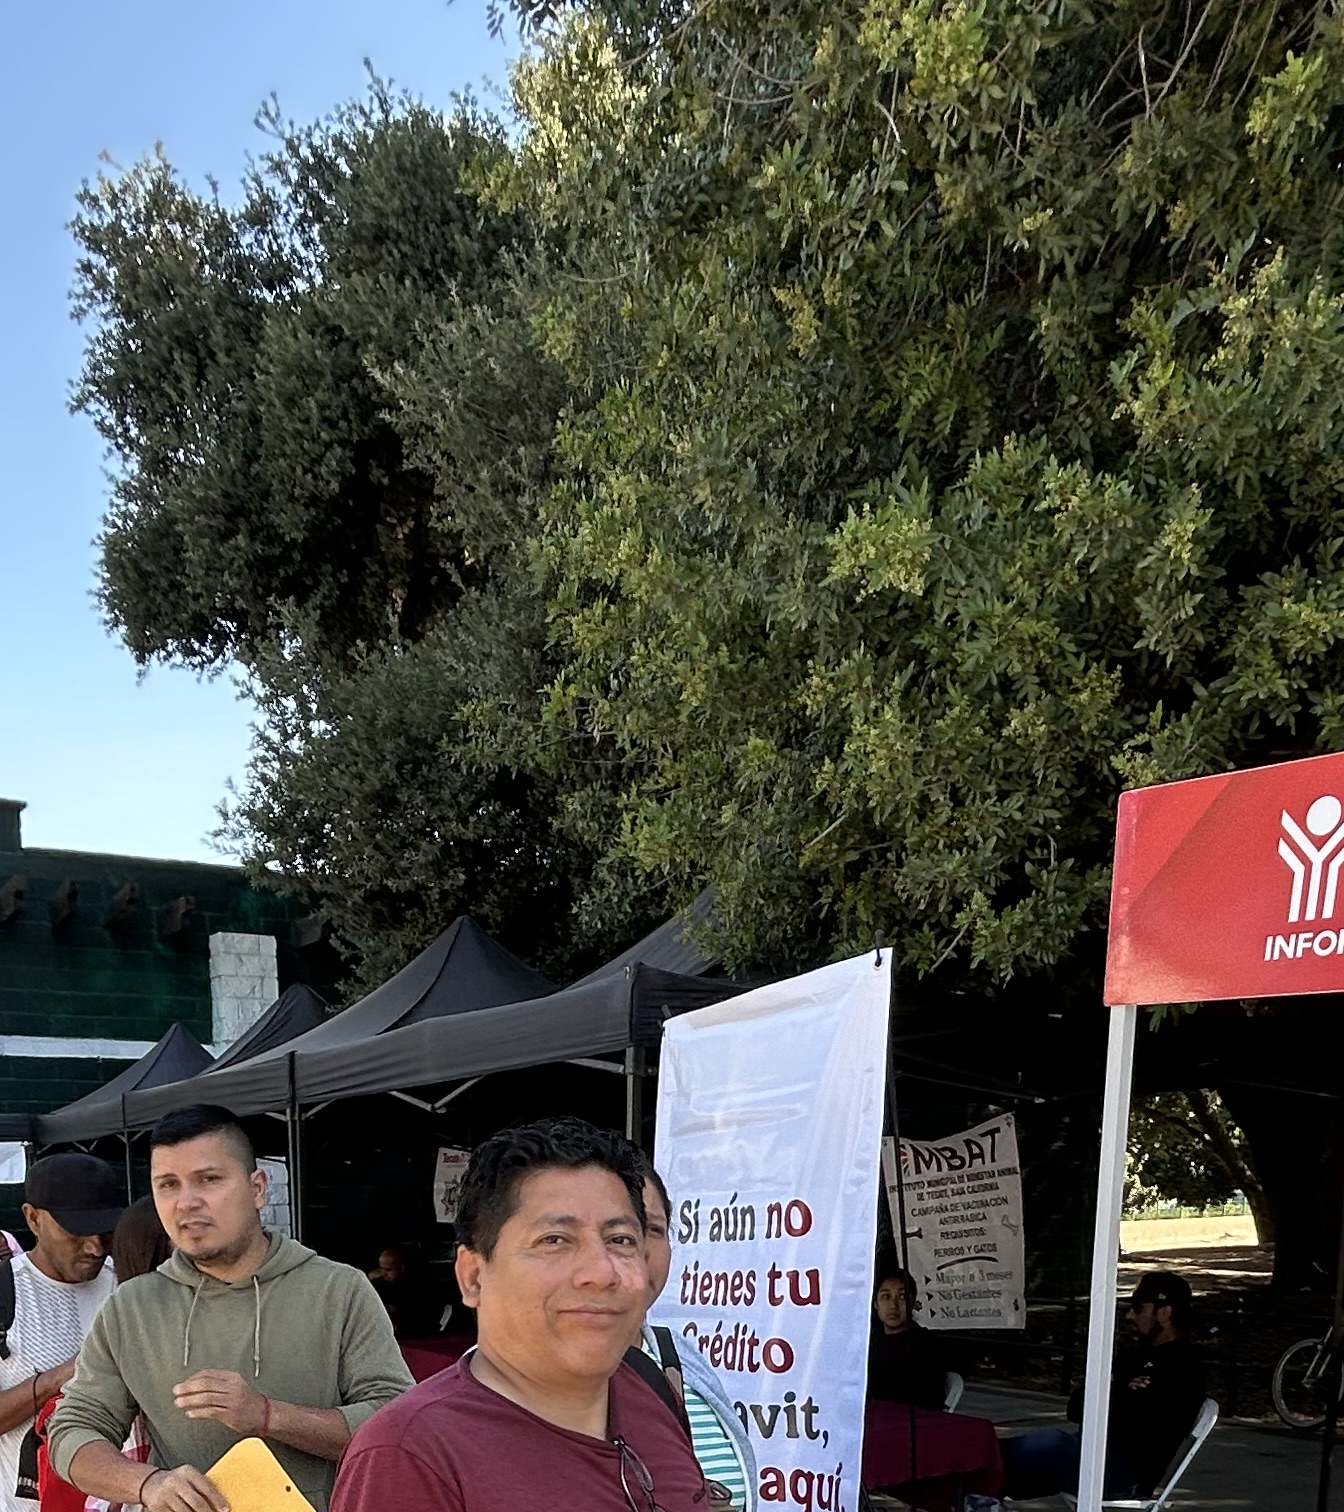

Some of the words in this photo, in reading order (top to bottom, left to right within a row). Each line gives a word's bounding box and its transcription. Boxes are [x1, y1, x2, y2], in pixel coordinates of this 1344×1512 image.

[906, 1126, 1001, 1175] MBAT
[710, 1192, 755, 1242] aún
[765, 1199, 813, 1239] no
[681, 1260, 756, 1306] tienes
[767, 1261, 821, 1306] tu
